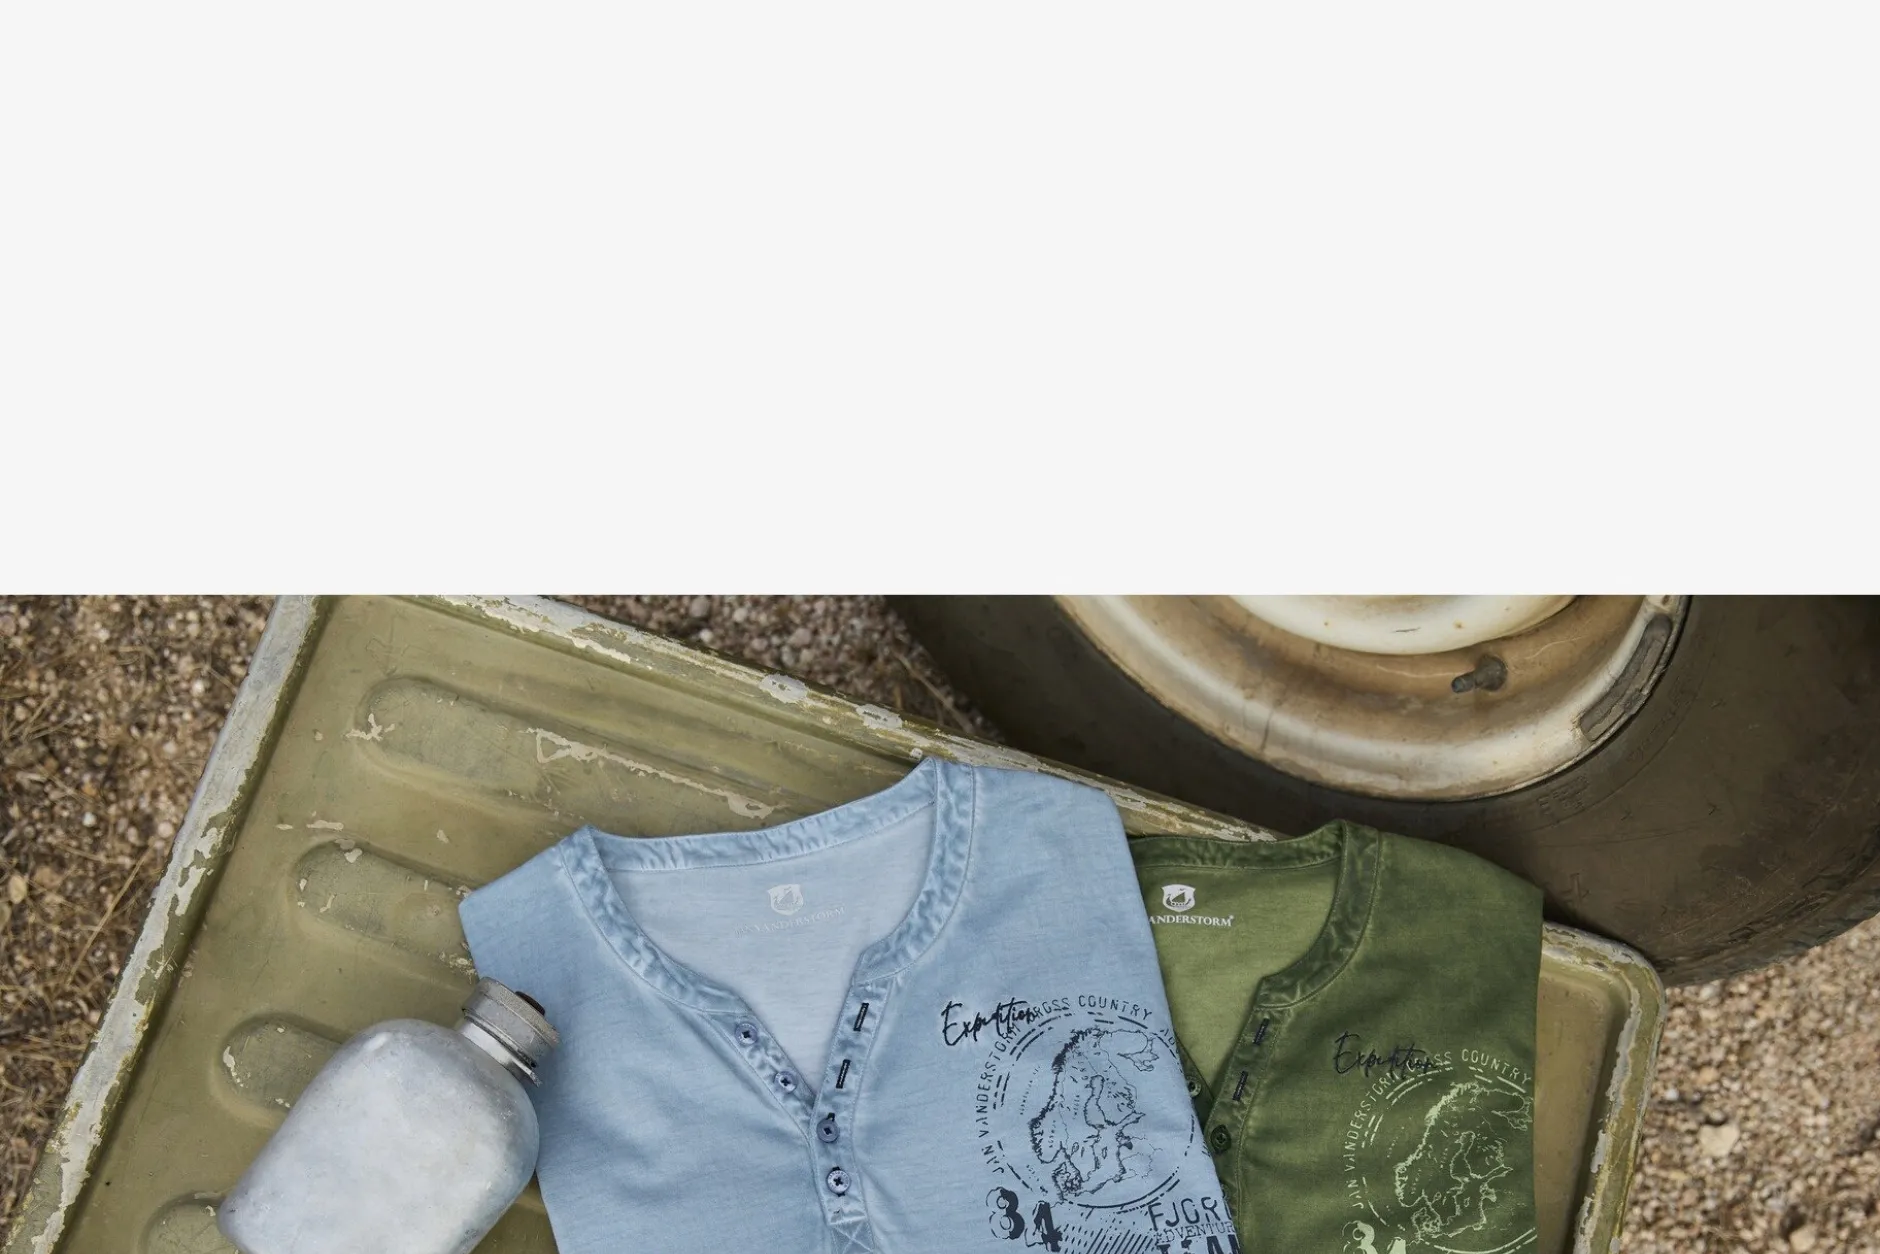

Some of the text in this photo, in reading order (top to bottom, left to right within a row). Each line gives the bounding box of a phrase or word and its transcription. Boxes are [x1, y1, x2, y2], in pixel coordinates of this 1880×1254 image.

[1149, 914, 1233, 927] ANDERSTORM
[1078, 995, 1152, 1020] COUNTRY
[1461, 1048, 1531, 1084] COUNTRY
[1147, 1196, 1232, 1231] FJOR
[1153, 1221, 1236, 1245] ADVENTUR
